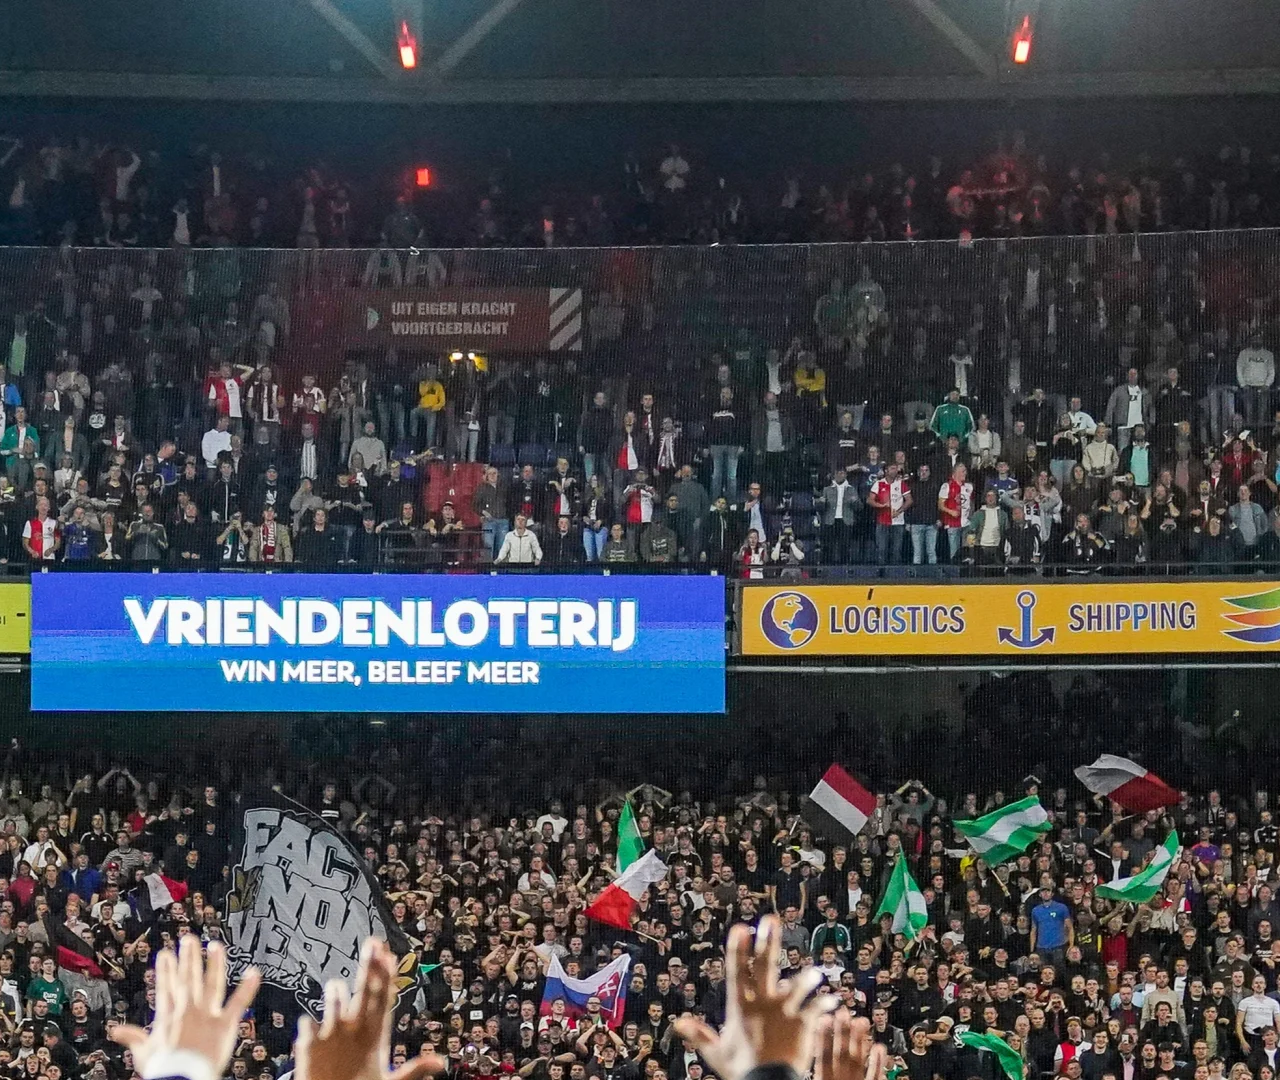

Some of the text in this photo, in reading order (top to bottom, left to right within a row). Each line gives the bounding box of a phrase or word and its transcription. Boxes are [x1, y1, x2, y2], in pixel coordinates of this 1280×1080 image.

[391, 302, 517, 316] UIT EIGEN KRACHT
[391, 321, 509, 336] VOORTGEBRACHT
[123, 597, 638, 652] VRIENDENLOTERIJ
[829, 603, 966, 636] LOGISTICS
[1068, 600, 1197, 633] SHIPPING
[220, 660, 540, 687] WIN MEER, BELEEF MEER
